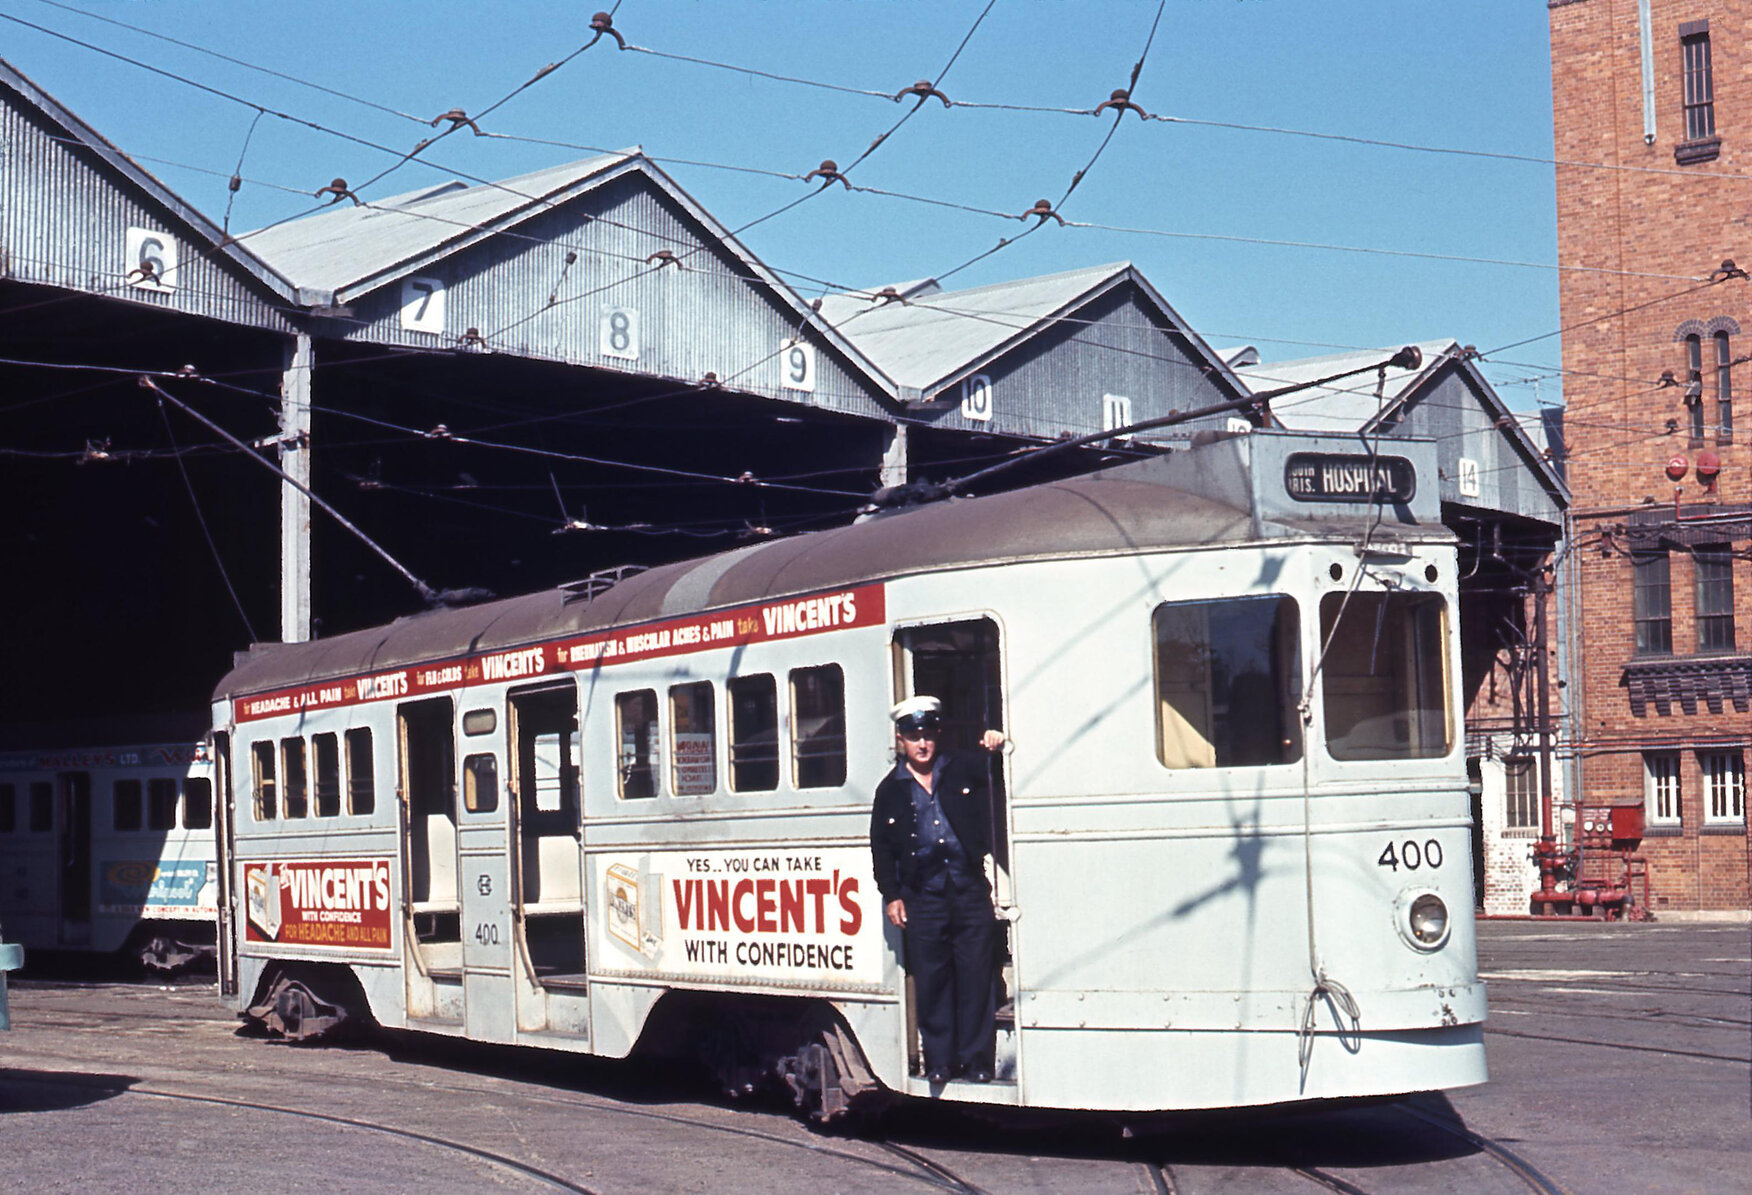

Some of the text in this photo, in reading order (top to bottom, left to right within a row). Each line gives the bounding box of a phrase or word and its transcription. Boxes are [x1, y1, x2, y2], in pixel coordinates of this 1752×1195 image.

[139, 237, 164, 282] 6
[412, 281, 433, 321] 7
[610, 311, 630, 350] 8
[790, 346, 806, 383] 9
[967, 377, 987, 413] 10
[1112, 400, 1124, 430] 11
[1463, 462, 1477, 491] 14
[618, 641, 626, 655] &
[626, 630, 671, 654] MUSCULAR
[672, 625, 701, 646] ACHES
[702, 626, 710, 642] &
[710, 620, 734, 640] PAIN
[737, 616, 759, 635] take
[762, 592, 857, 636] VINCENT'S
[481, 647, 545, 681] VINCENT'S
[251, 696, 291, 715] HEADACHE
[300, 691, 318, 706] ALL
[320, 687, 342, 703] PAIN
[356, 671, 408, 700] VINCENT'S
[753, 857, 779, 872] CAN
[786, 856, 822, 871] TAKE
[1378, 838, 1443, 872] 400
[287, 860, 389, 911] VINCENT'S
[672, 869, 862, 936] VINCENT'S
[285, 923, 387, 943] FOR HEADACHE AND ALL PAIN
[301, 911, 362, 923] WITH CONFIDENCE
[475, 923, 498, 946] 400
[685, 940, 854, 971] WITH CONFIDENCE
